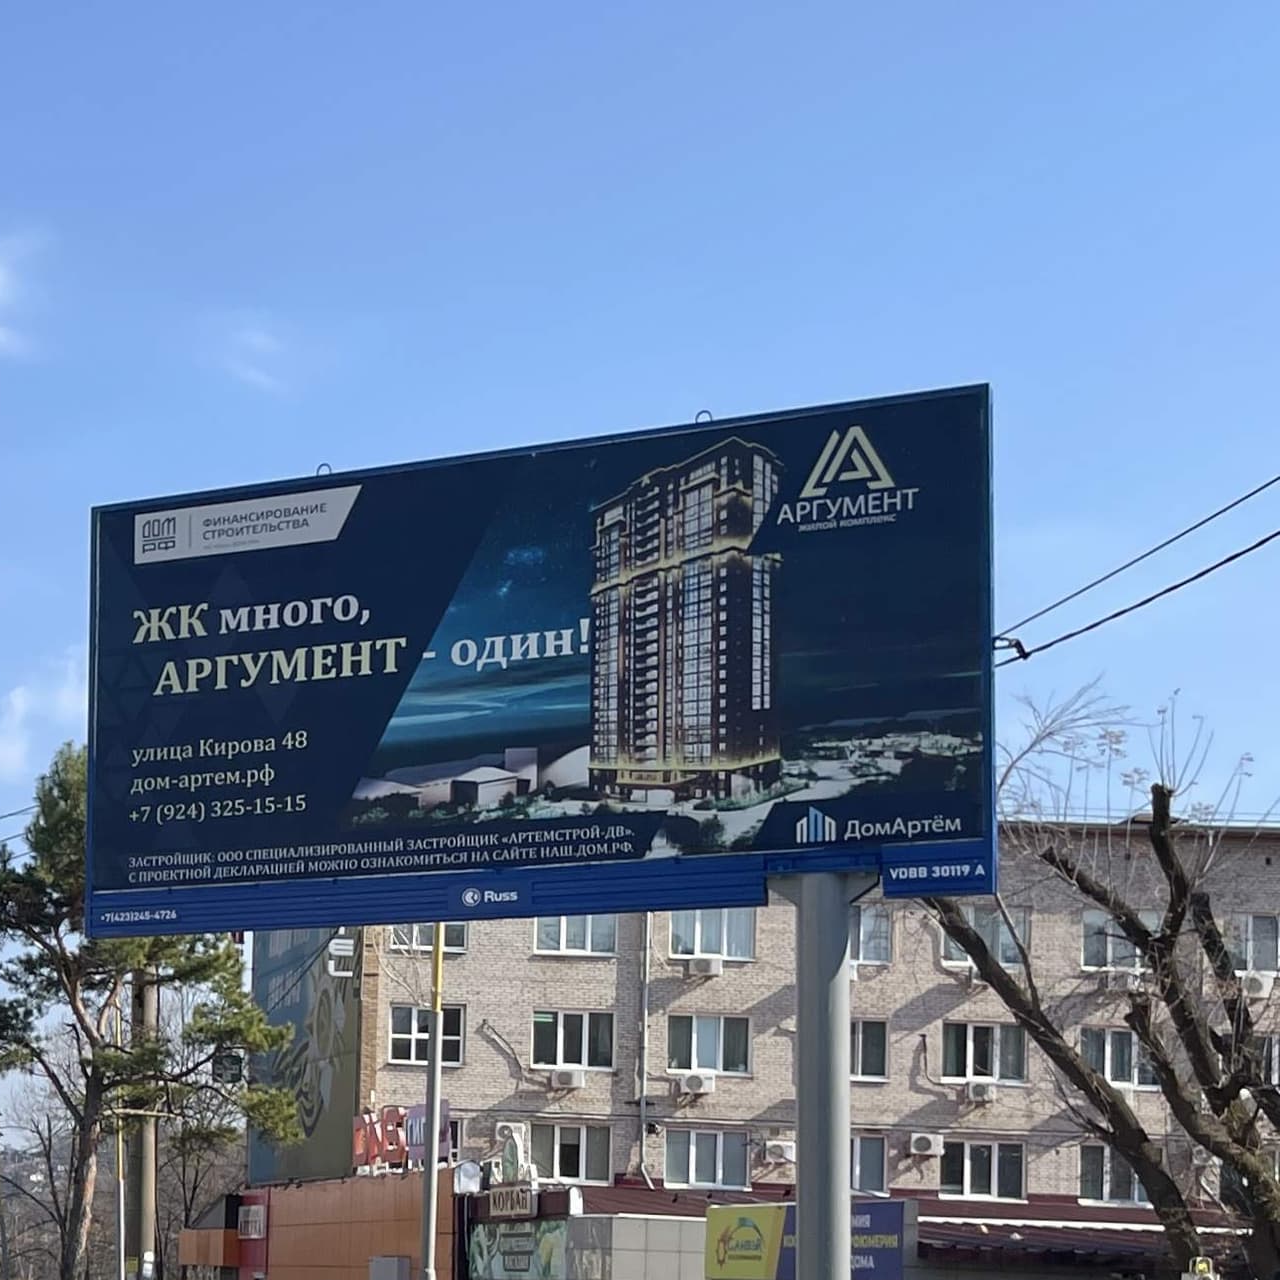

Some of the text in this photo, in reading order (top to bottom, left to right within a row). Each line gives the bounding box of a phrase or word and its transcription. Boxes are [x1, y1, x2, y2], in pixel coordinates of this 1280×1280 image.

[203, 503, 327, 528] ФИНАНСИРОВАНИЕ
[777, 488, 919, 525] АРГУМЕНТ
[202, 518, 310, 541] СТРОИТЕЛЬСТВА
[132, 594, 371, 645] ЖК много,
[153, 637, 407, 696] АРГУМЕНТ
[450, 617, 591, 672] один!
[131, 730, 309, 766] улица Кирова 48
[130, 763, 276, 796] дом-артем.рф
[128, 794, 307, 826] +7 (924) 325-15-15
[844, 814, 962, 841] ДомАртём
[128, 851, 215, 868] ЗАСТРОЙЩИК:
[217, 851, 243, 863] ООО
[245, 838, 404, 861] СПЕЦИАЛИЗИРОВАННЫЙ
[407, 833, 499, 850] ЗАСТРОЙЩИК
[128, 872, 136, 883] С
[138, 865, 211, 882] ПРОЕКТНОЙ
[213, 860, 305, 880] ДЕКЛАРАЦИЕЙ
[308, 859, 358, 872] МОЖНО
[360, 852, 468, 869] ОЗНАКОМИТЬСЯ
[471, 850, 490, 862] НА
[492, 844, 537, 860] САЙТЕ
[931, 863, 971, 878] 30119
[484, 889, 518, 903] Russ
